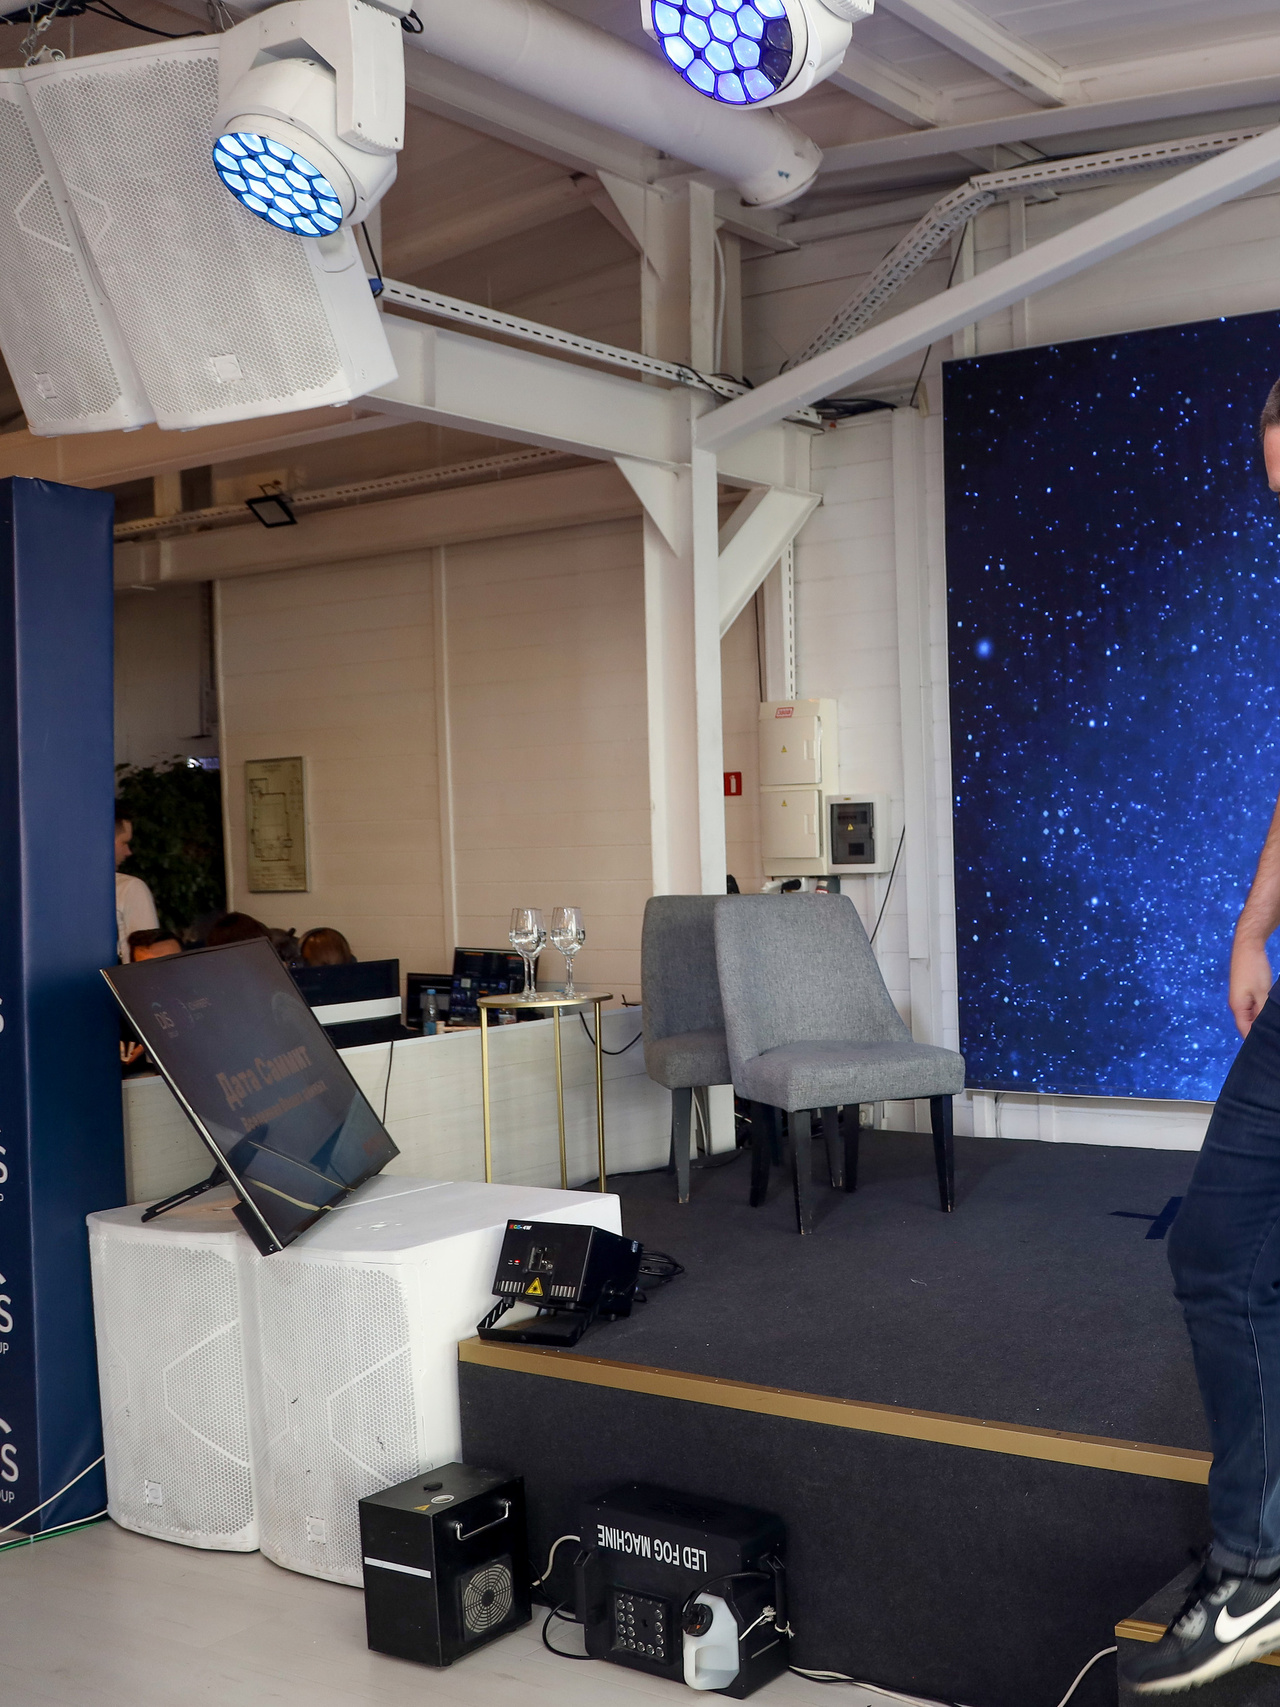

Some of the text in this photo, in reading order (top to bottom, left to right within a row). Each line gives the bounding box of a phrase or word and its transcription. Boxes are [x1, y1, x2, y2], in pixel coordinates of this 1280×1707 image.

[216, 1071, 263, 1112] Дата
[597, 1524, 707, 1573] LED FOG MACHINE
